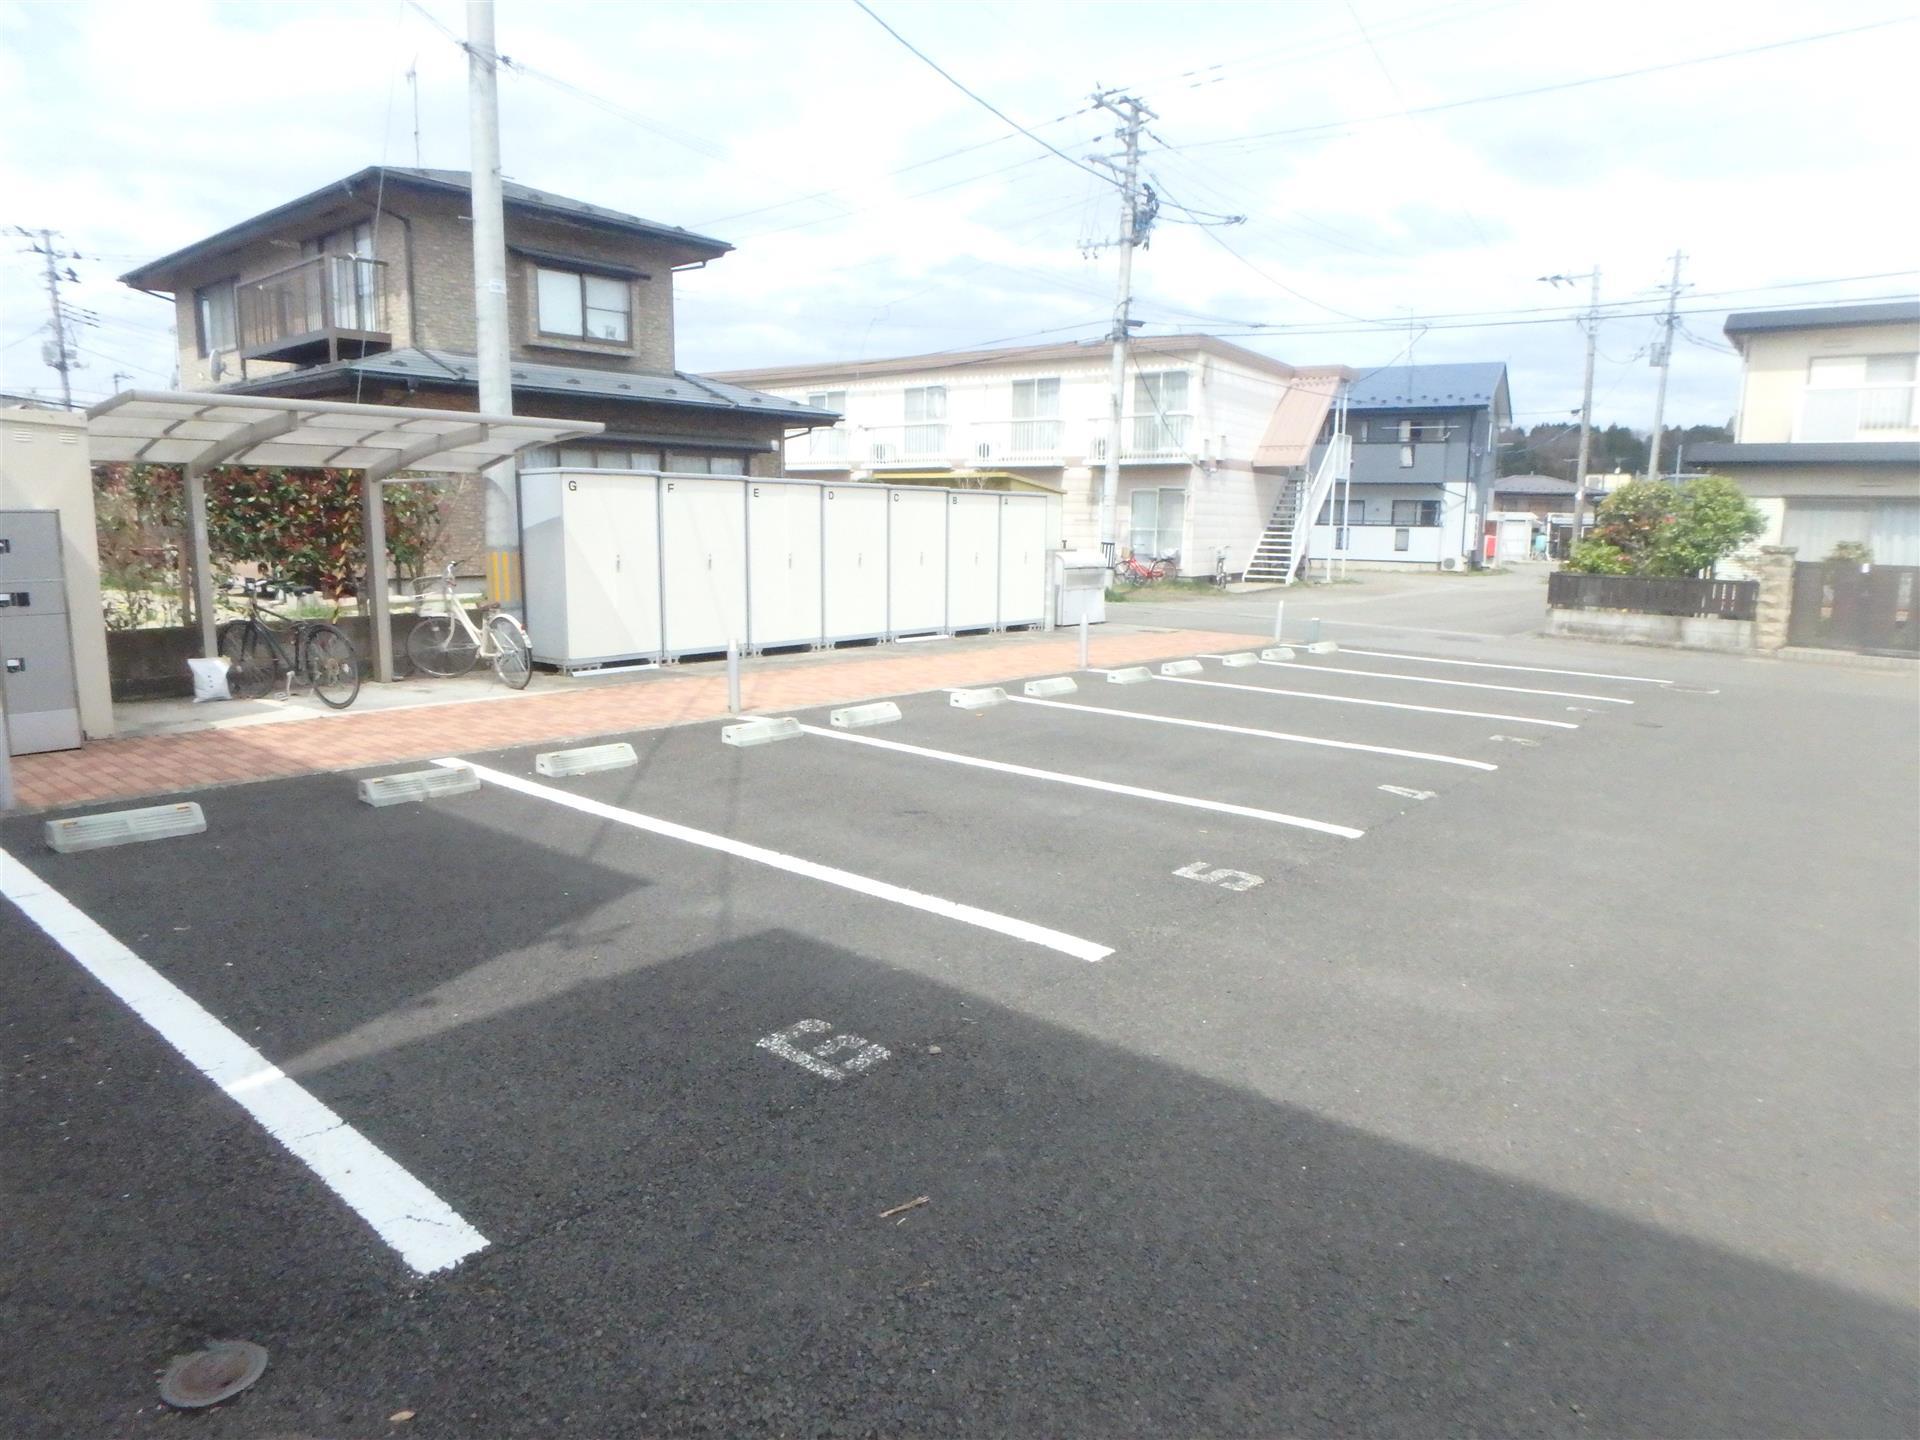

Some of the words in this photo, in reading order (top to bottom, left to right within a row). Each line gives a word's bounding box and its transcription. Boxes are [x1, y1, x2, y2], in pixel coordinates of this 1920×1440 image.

[568, 480, 577, 492] G
[667, 483, 675, 494] F
[753, 487, 760, 498] E
[828, 490, 835, 501] D
[893, 493, 900, 503] C
[1171, 861, 1264, 892] 5
[755, 1018, 892, 1080] 6
